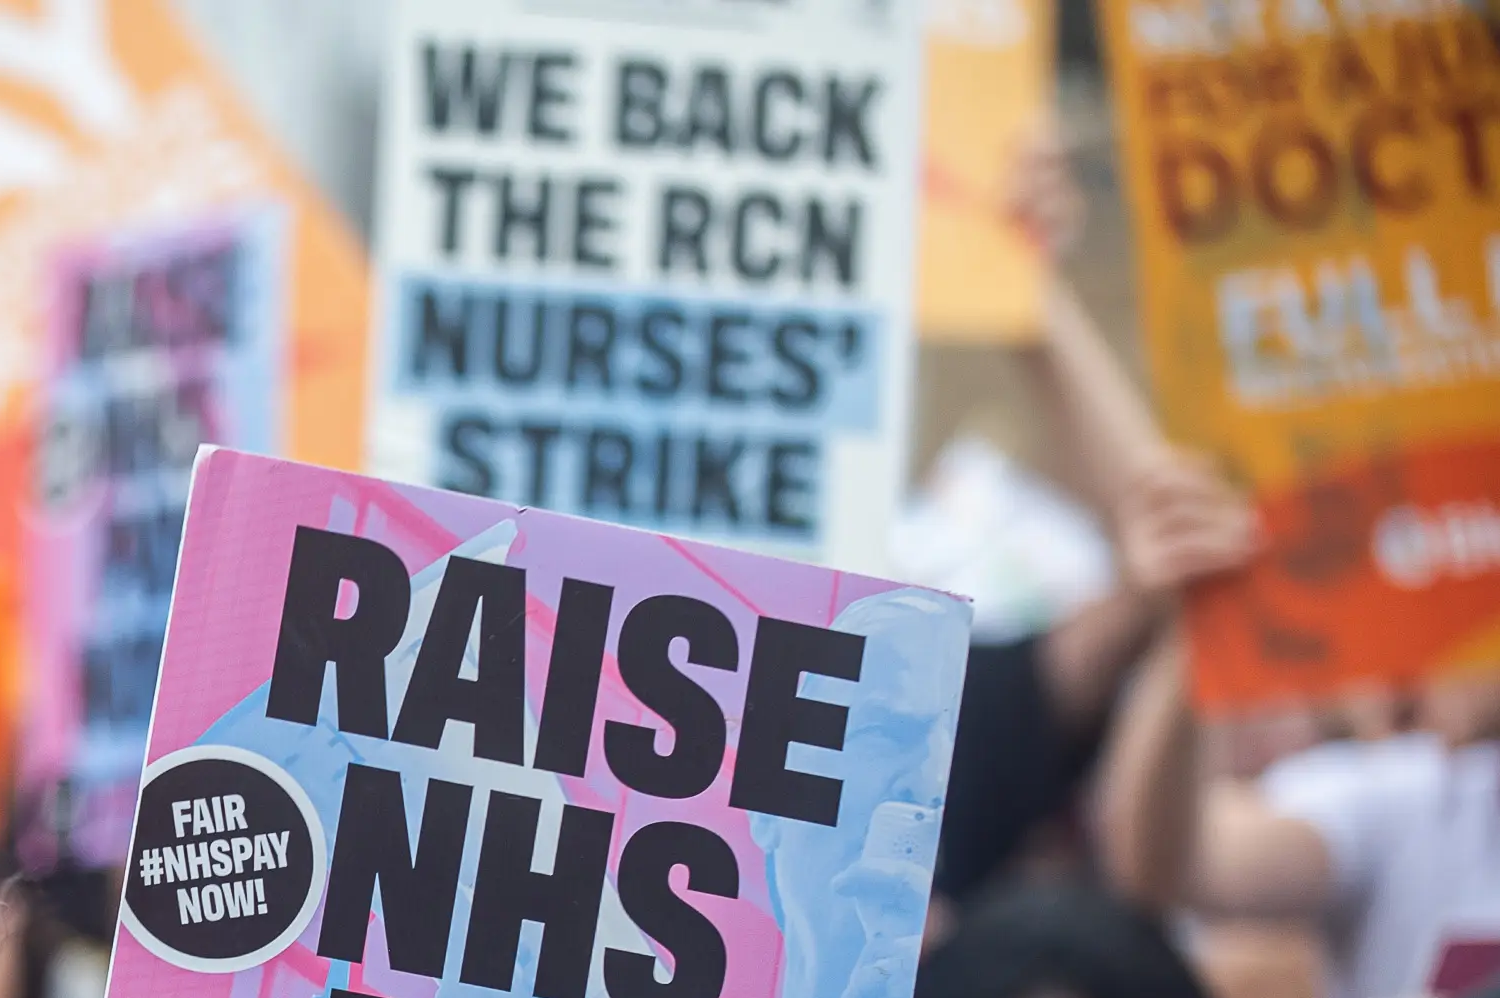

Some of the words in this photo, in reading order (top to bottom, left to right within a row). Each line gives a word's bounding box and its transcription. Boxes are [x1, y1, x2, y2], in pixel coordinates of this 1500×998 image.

[420, 42, 580, 142] WE
[614, 60, 880, 168] BACK
[430, 168, 622, 268] THE
[658, 186, 864, 286] RCN
[442, 416, 822, 532] STRIKE
[265, 524, 867, 828] RAISE
[139, 830, 290, 886] #NHSPAY
[171, 793, 249, 838] FAIR
[176, 877, 268, 925] NOW!
